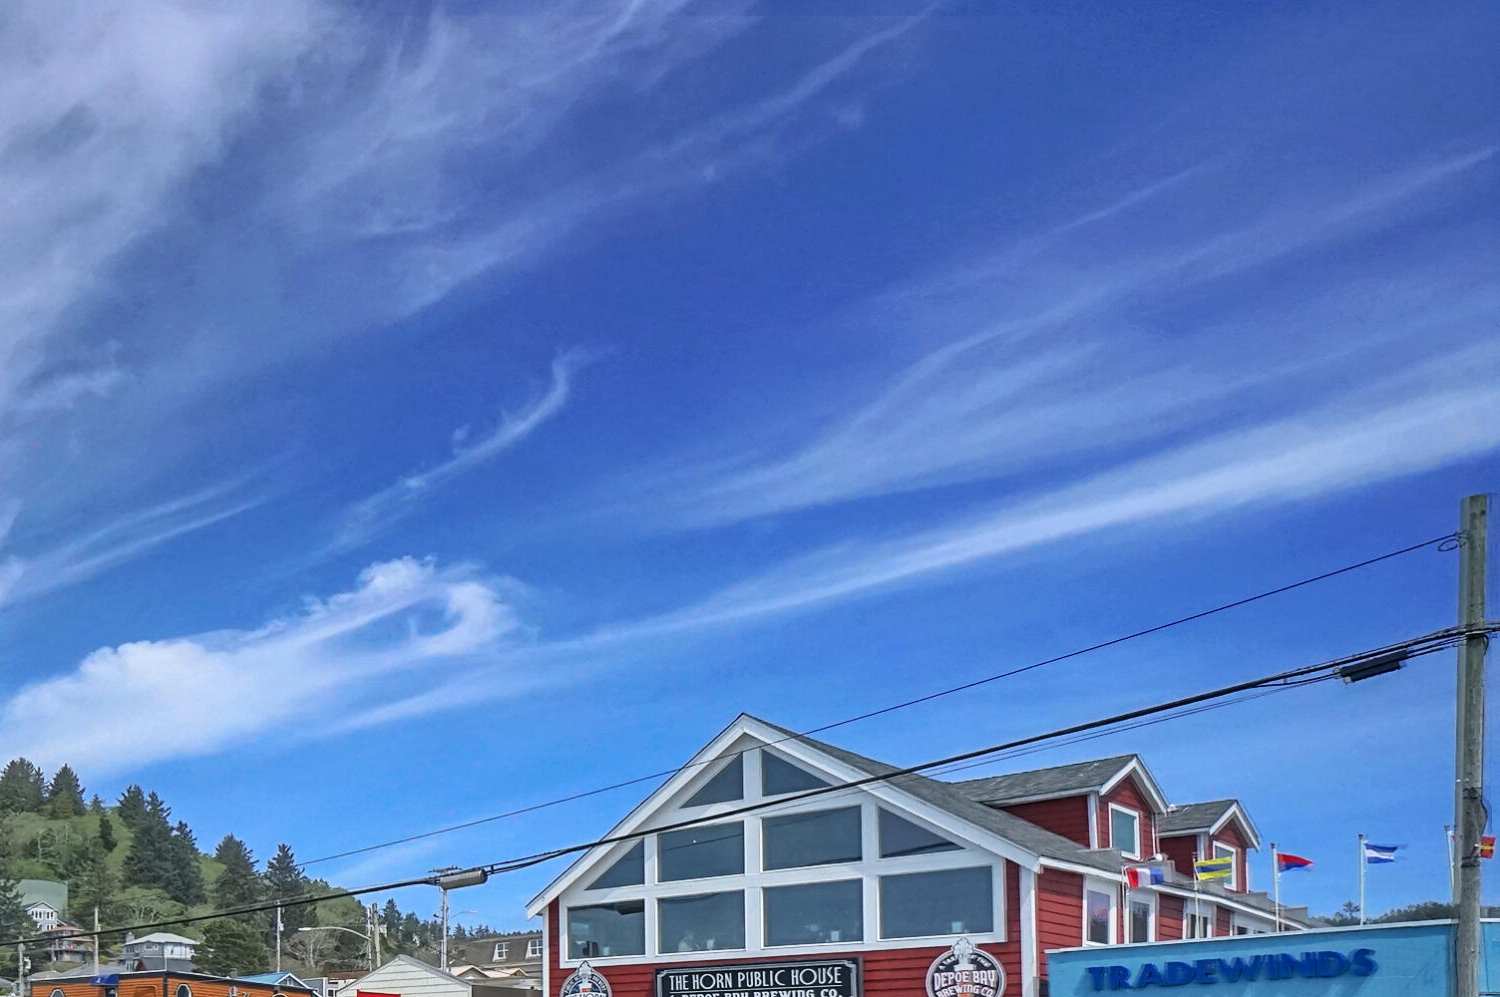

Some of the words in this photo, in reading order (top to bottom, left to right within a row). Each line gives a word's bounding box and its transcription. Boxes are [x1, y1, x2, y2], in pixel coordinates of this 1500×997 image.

[669, 975, 689, 991] THE
[692, 972, 732, 990] HORN
[738, 970, 786, 988] PUBLIC
[791, 967, 842, 986] HOUSE
[933, 970, 970, 991] DEPOE
[972, 969, 997, 988] BAY
[1088, 948, 1377, 992] TRADEWINDS
